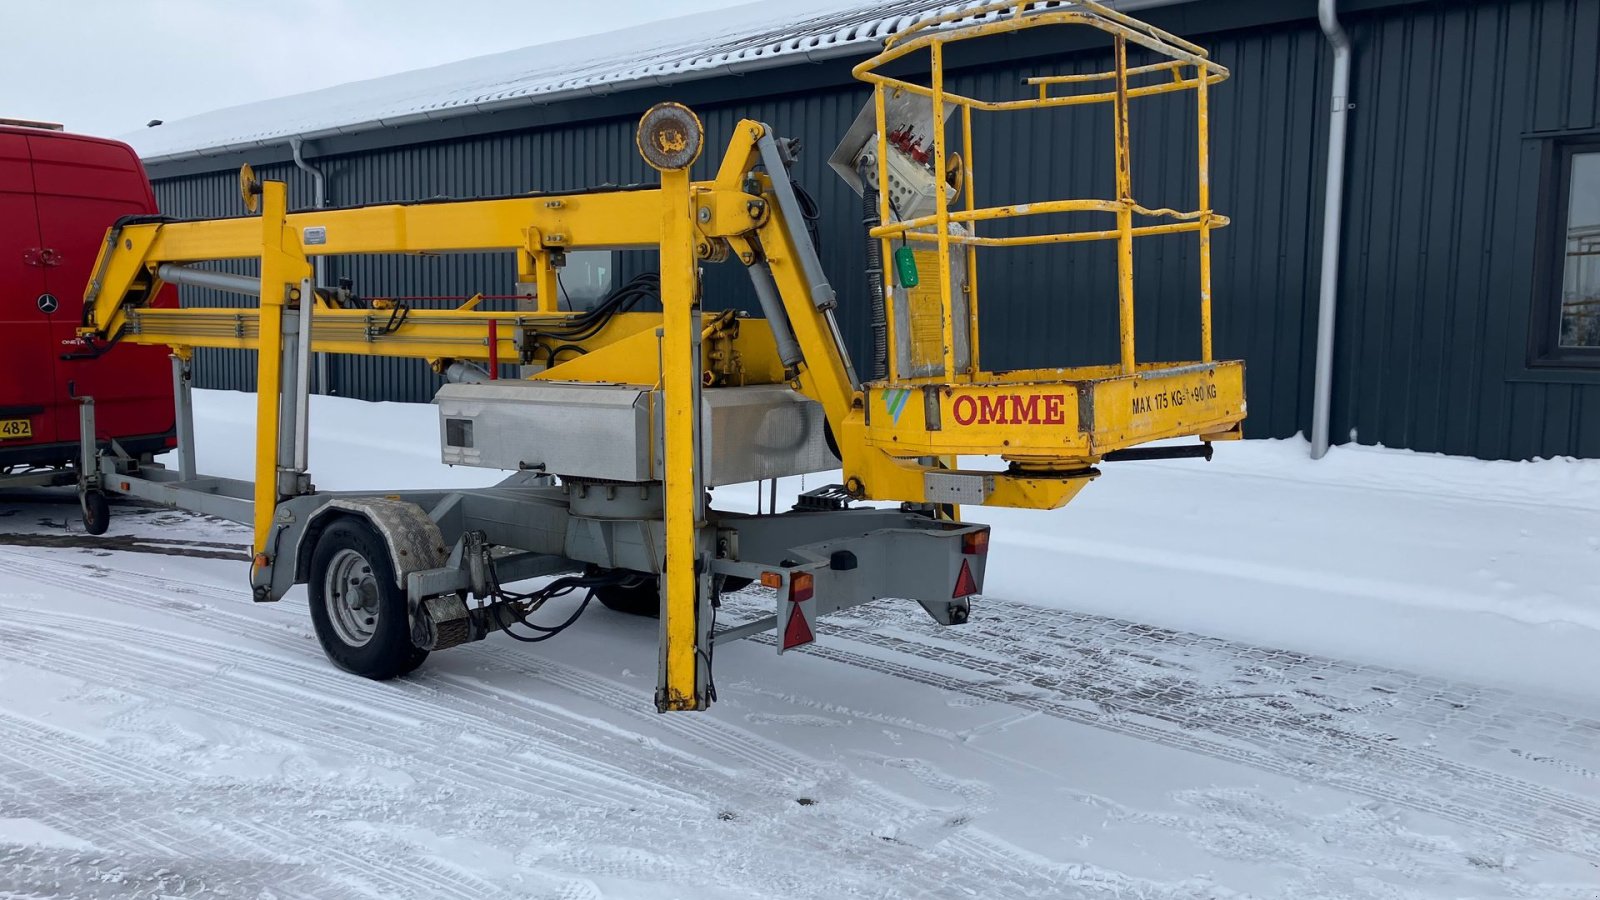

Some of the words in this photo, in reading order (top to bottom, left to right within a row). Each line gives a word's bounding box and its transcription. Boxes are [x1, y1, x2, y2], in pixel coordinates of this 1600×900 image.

[953, 394, 1065, 426] OMME
[1132, 395, 1152, 415] MAX
[1155, 393, 1168, 410] 175
[1206, 384, 1217, 399] KG
[3, 421, 30, 435] 482
